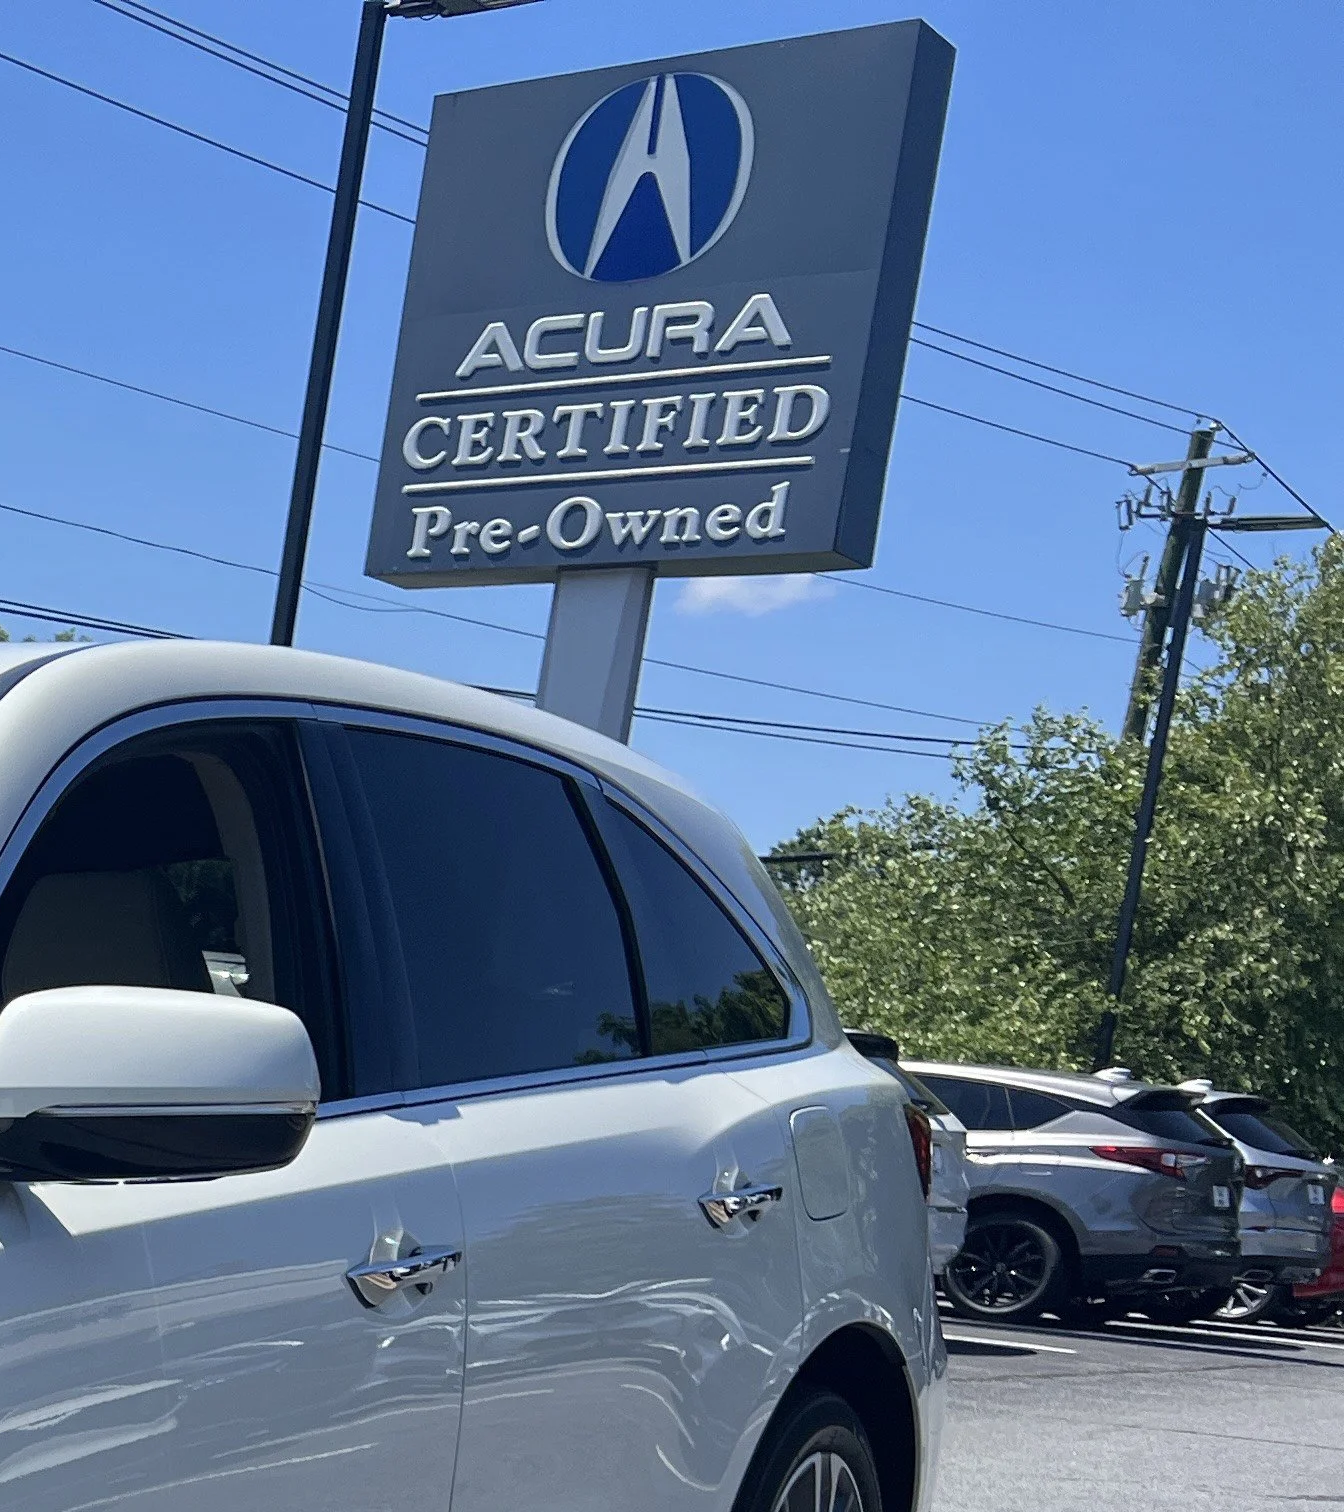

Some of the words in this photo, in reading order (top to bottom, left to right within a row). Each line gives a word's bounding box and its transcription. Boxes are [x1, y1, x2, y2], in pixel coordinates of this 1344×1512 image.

[454, 292, 794, 378] ACURA
[402, 384, 831, 470] CERTIFIED
[406, 481, 791, 559] Pre-Owned
